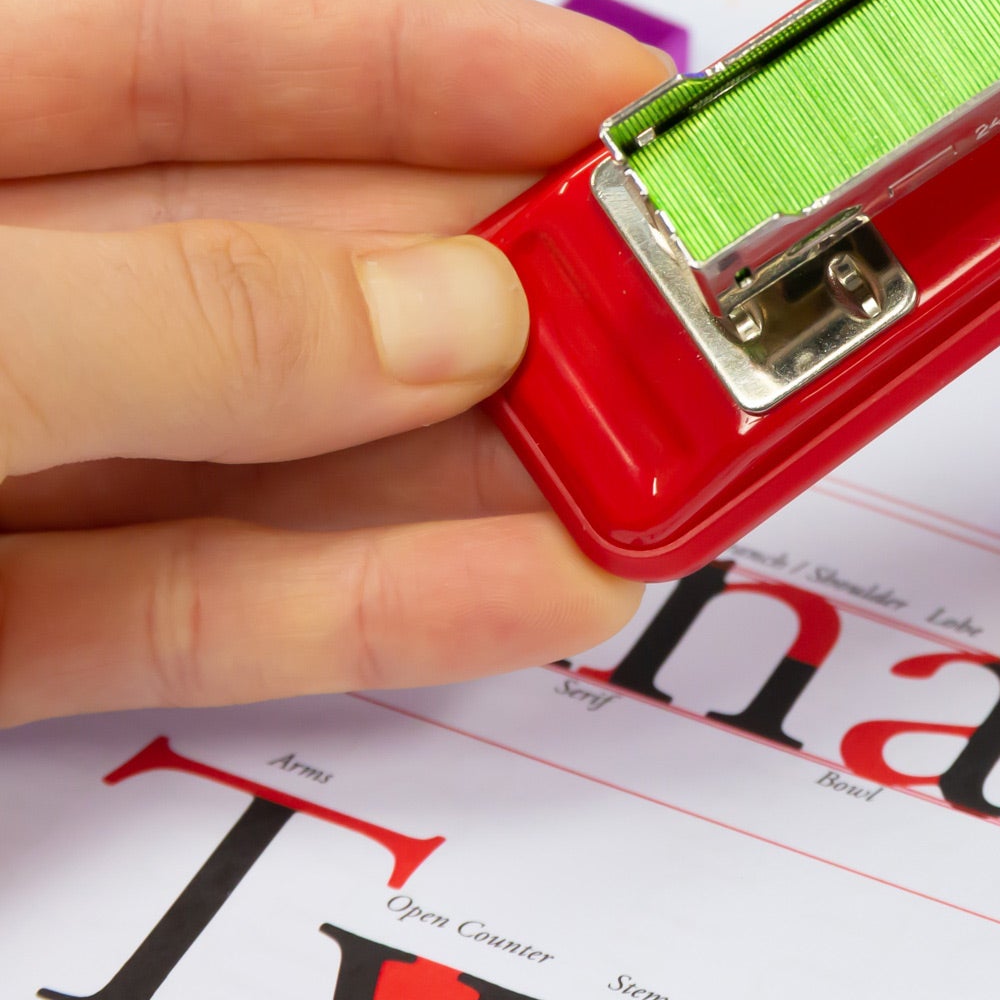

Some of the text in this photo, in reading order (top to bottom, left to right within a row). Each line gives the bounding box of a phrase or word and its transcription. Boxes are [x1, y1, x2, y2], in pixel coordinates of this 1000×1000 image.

[554, 680, 621, 711] Serif
[267, 752, 334, 784] Arms
[815, 770, 884, 802] Bowl
[386, 894, 555, 964] Open Counter
